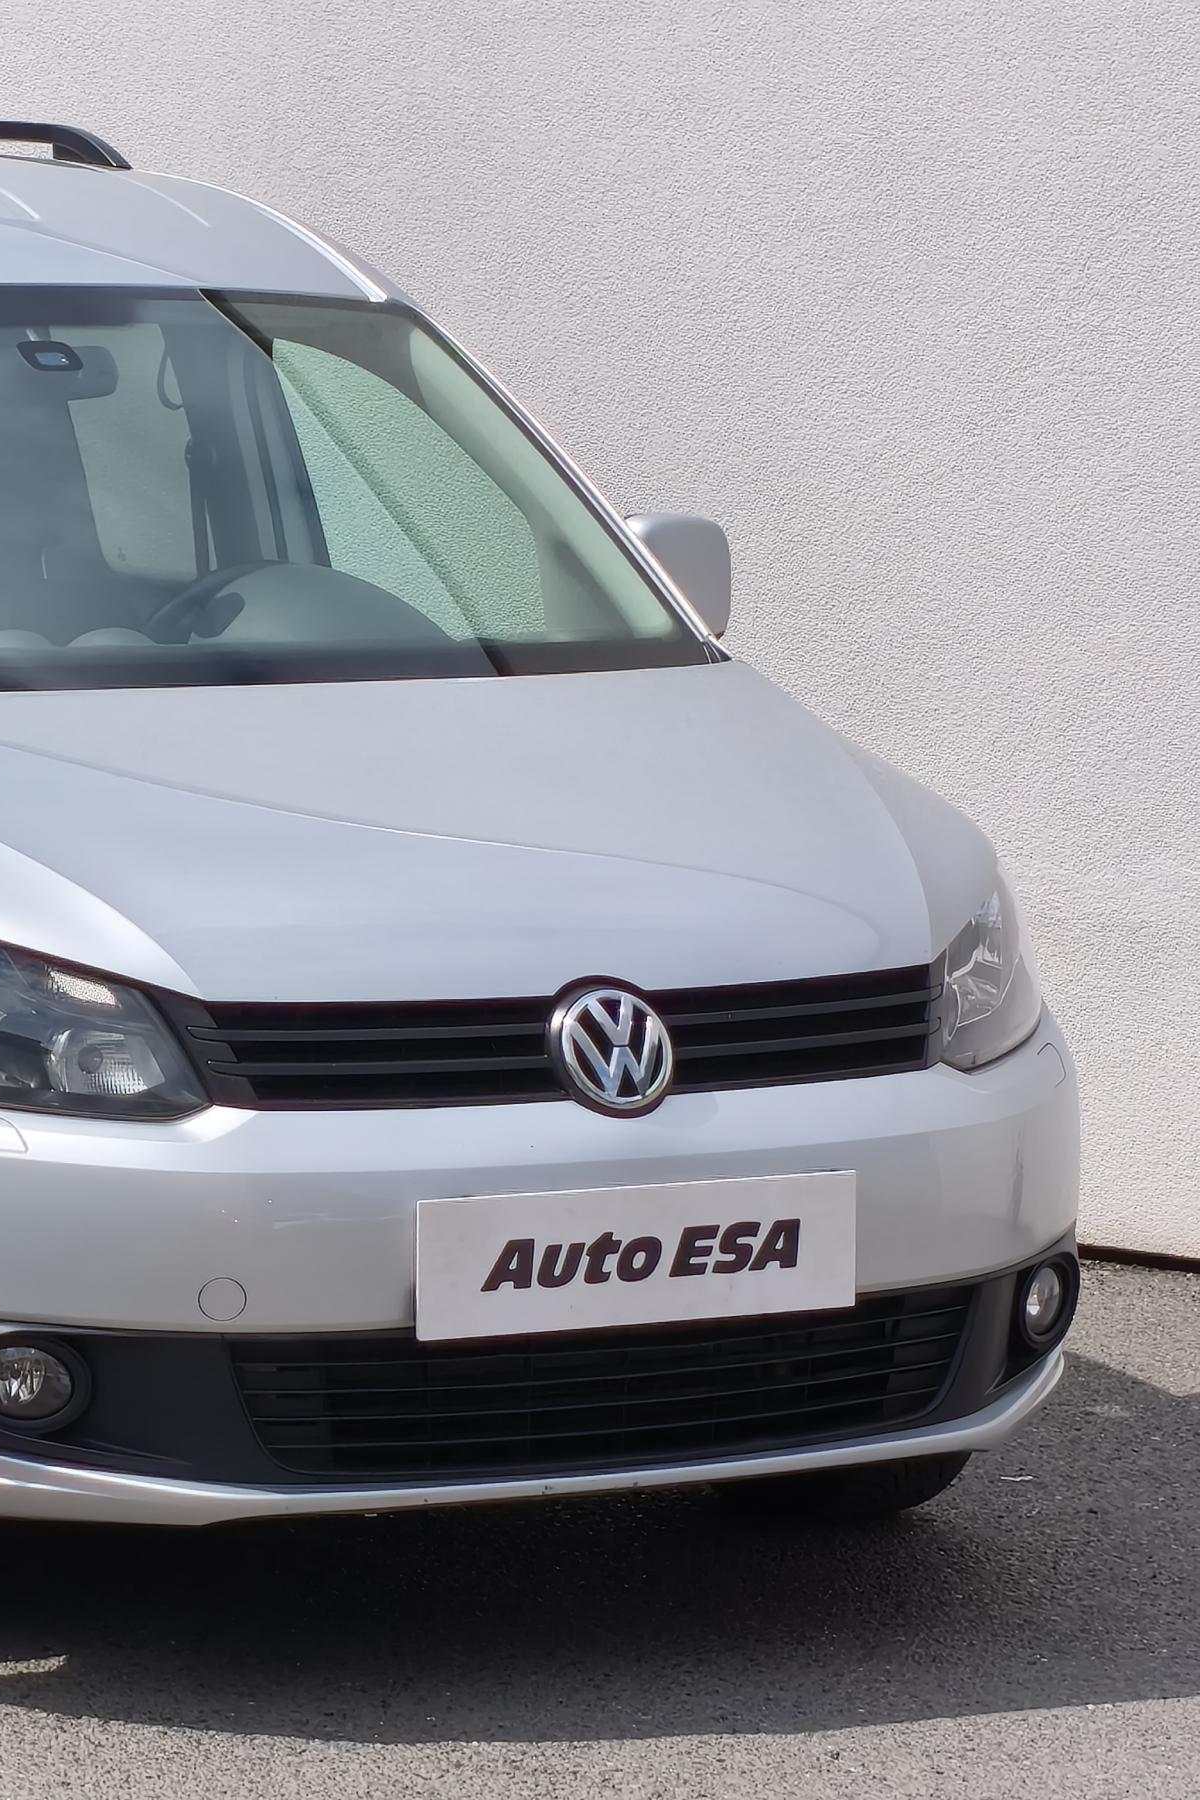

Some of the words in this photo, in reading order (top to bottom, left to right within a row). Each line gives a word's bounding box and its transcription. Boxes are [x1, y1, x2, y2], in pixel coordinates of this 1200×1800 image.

[564, 993, 666, 1102] VW
[481, 1232, 662, 1292] Auto
[669, 1219, 801, 1278] ESA
